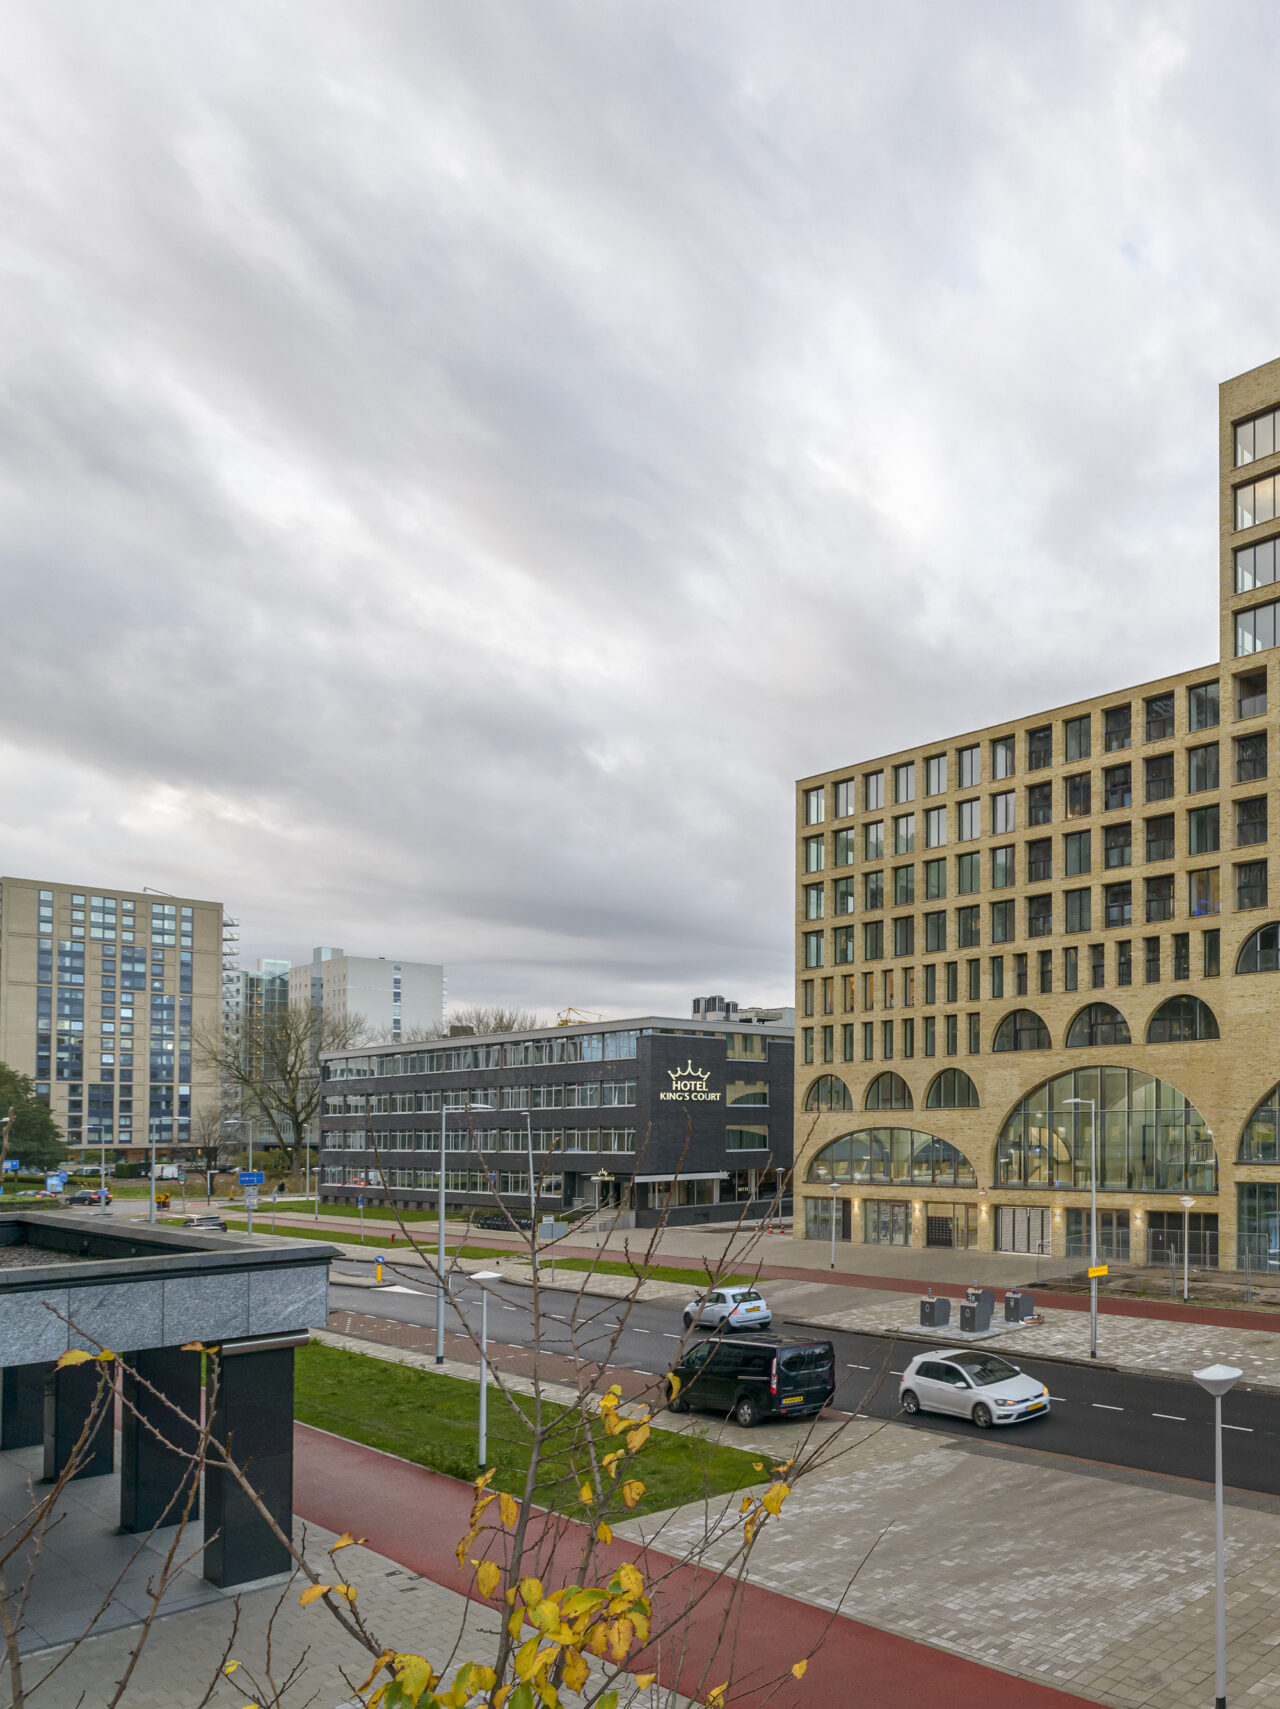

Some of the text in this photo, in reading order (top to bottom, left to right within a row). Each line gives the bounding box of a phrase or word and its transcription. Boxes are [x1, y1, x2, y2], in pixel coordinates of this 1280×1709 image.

[672, 1080, 709, 1091] HOTEL
[660, 1092, 721, 1101] KING'S COURT
